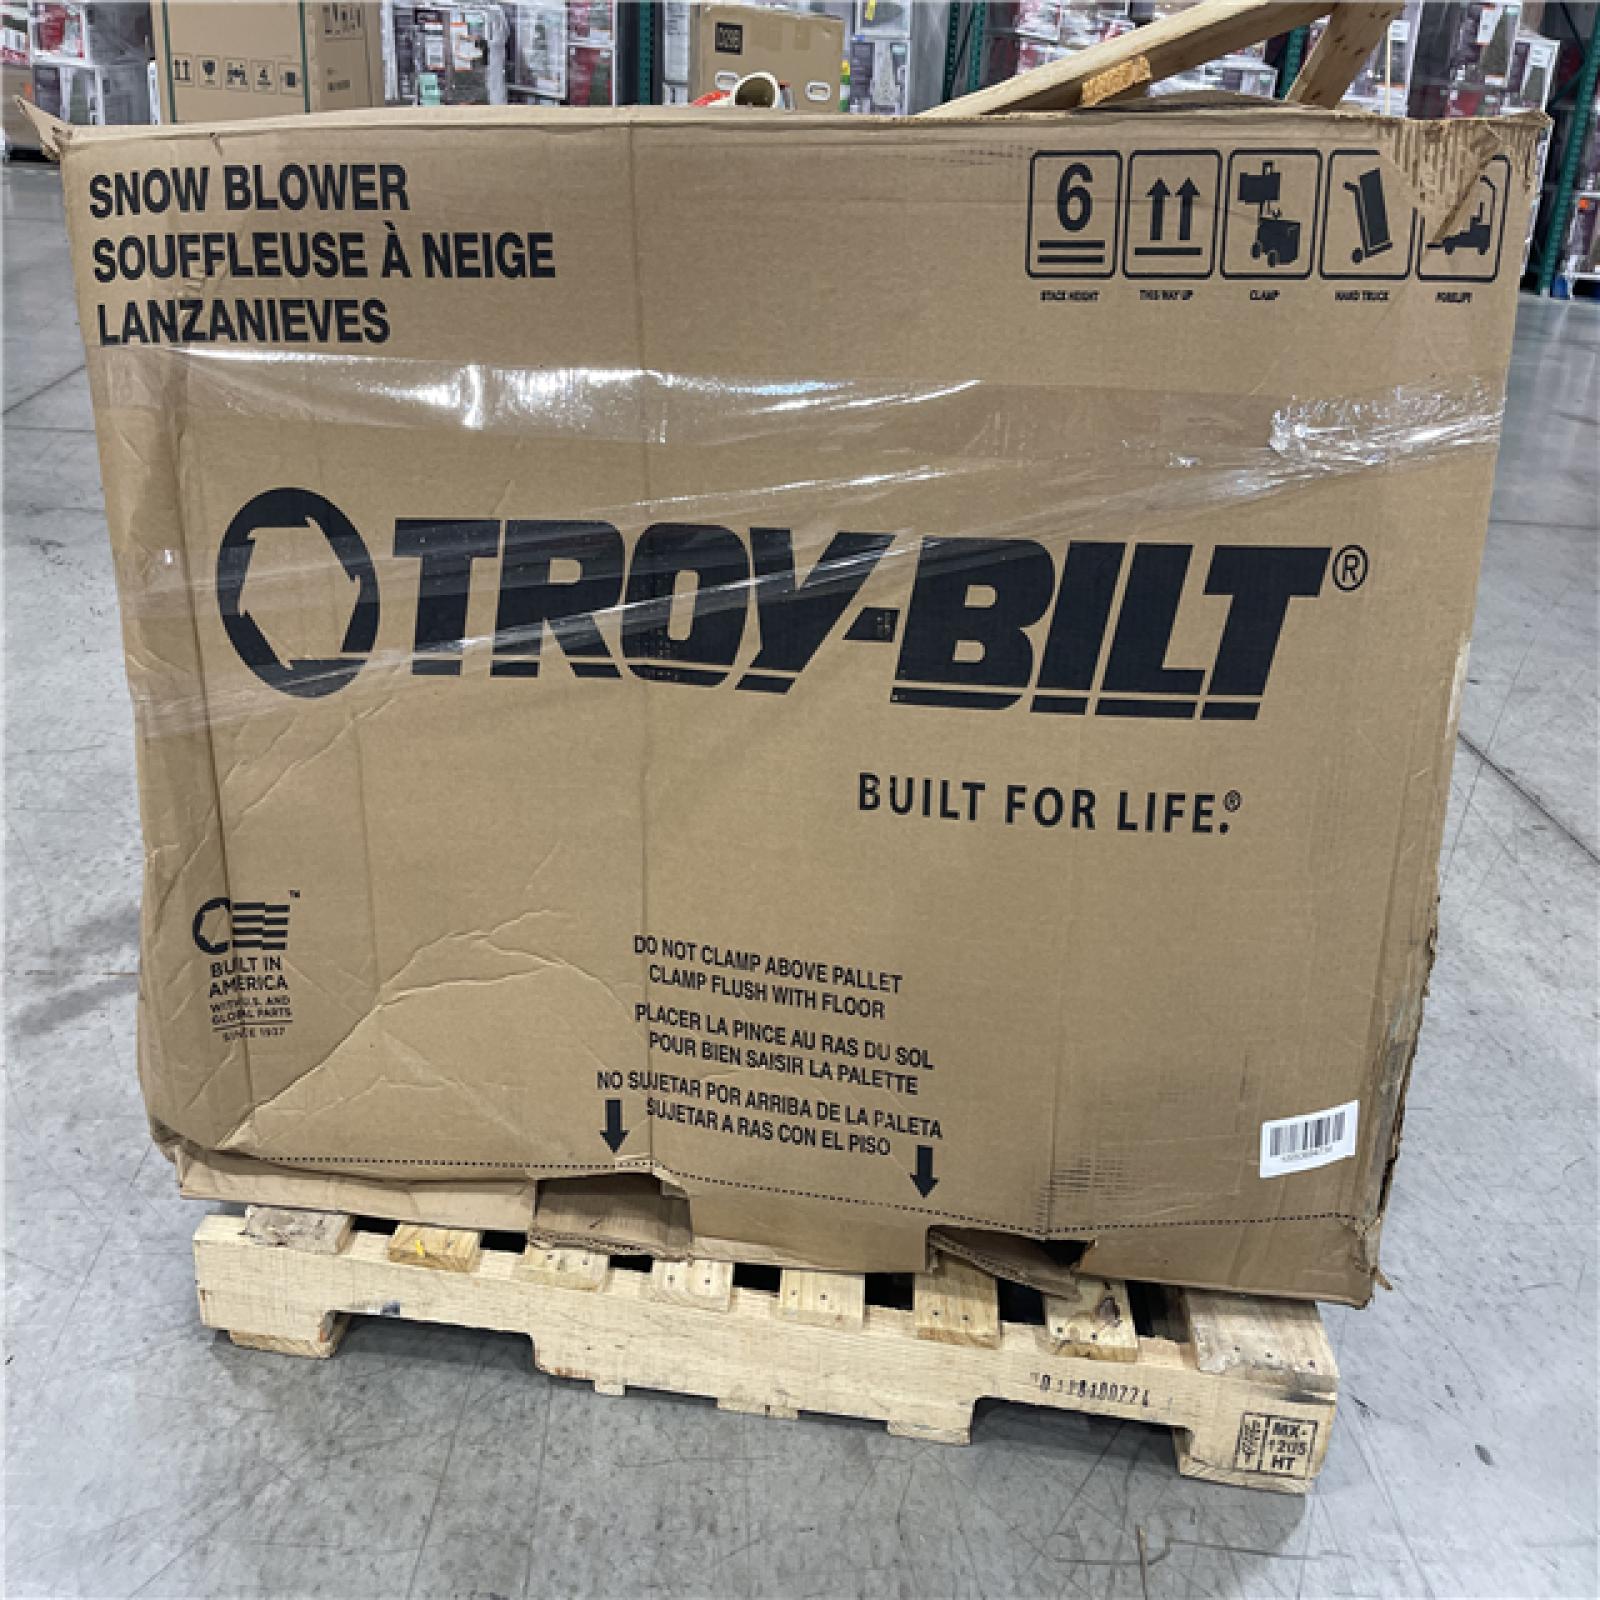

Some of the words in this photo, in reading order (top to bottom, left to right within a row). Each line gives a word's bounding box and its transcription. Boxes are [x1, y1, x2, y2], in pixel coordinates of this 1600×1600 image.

[89, 167, 209, 218] SNOW
[224, 164, 409, 211] BLOWER
[1057, 163, 1092, 231] 6
[94, 232, 367, 282] SOUFFLEUSE
[381, 221, 410, 278] À
[424, 232, 556, 279] NEIGE
[99, 299, 390, 346] LANZANIEVES
[858, 772, 985, 821] BUILT
[1005, 785, 1095, 829] FOR
[209, 975, 288, 997] AMERICA
[210, 957, 257, 977] BUILT
[263, 956, 281, 971] IN
[633, 935, 658, 956] DO
[662, 938, 697, 962] NOT
[702, 945, 761, 972] CLAMP
[765, 956, 828, 983] ABOVE
[832, 965, 903, 993] PALLET
[649, 965, 705, 990] CLAMP
[711, 975, 767, 1002] FLUSH
[772, 985, 816, 1010] WITH
[822, 992, 885, 1019] FLOOR
[635, 1003, 700, 1030] PLACER
[705, 1014, 728, 1036] LA
[733, 1019, 785, 1045] PINCE
[791, 1030, 815, 1050] AU
[822, 1034, 858, 1057] RAS
[864, 1042, 890, 1061] DU
[895, 1047, 934, 1070] SOL
[650, 1032, 696, 1057] POUR
[702, 1041, 740, 1066] BIEN
[746, 1050, 803, 1076] SAISIR
[810, 1060, 832, 1080] LA
[838, 1064, 919, 1095] PALETTE
[597, 1071, 622, 1090] NO
[628, 1071, 700, 1098] SUJETAR
[707, 1082, 741, 1105] POR
[745, 1090, 812, 1118] ARRIBA
[817, 1102, 840, 1122] DE
[846, 1107, 869, 1127] LA
[875, 1111, 943, 1139] PALETA
[646, 1098, 718, 1130] SUJETAR
[722, 1114, 734, 1134] A
[737, 1117, 773, 1140] RAS
[779, 1124, 816, 1147] CON
[822, 1130, 843, 1151] EL
[850, 1134, 891, 1155] PISO
[1272, 1455, 1295, 1470] HT
